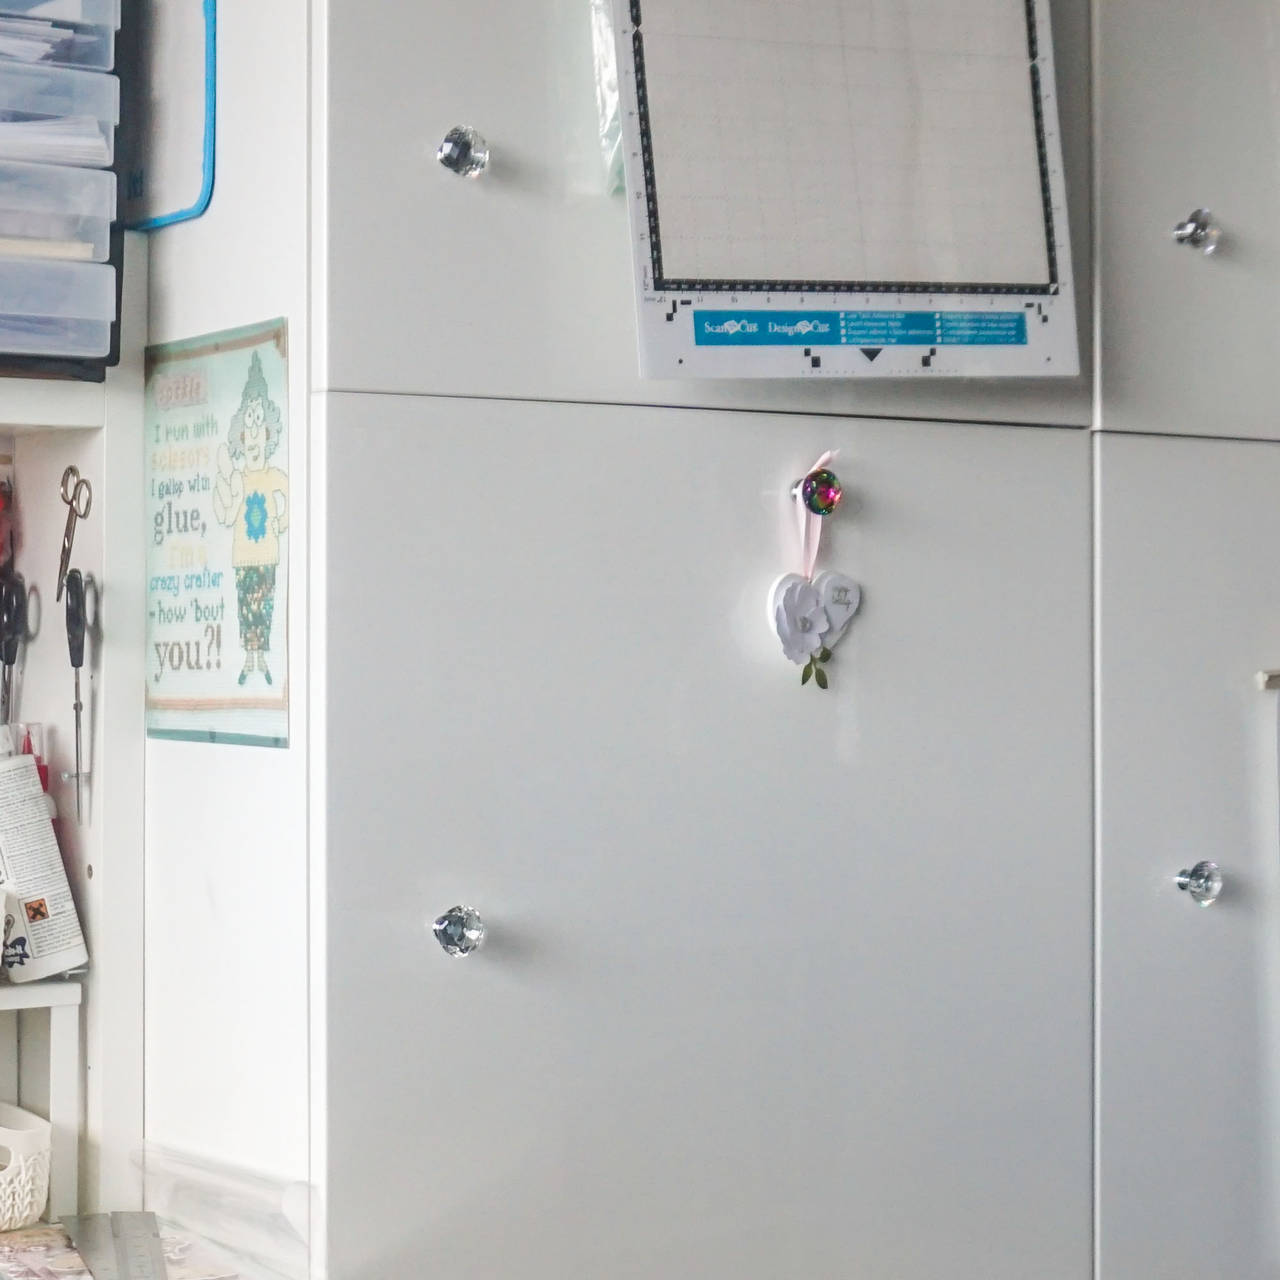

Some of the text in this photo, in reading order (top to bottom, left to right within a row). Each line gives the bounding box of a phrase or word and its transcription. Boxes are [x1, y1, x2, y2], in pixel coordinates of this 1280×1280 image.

[165, 423, 189, 442] run
[193, 411, 219, 438] with
[153, 500, 207, 546] glue,
[150, 575, 180, 597] crazy
[153, 624, 222, 683] you?!
